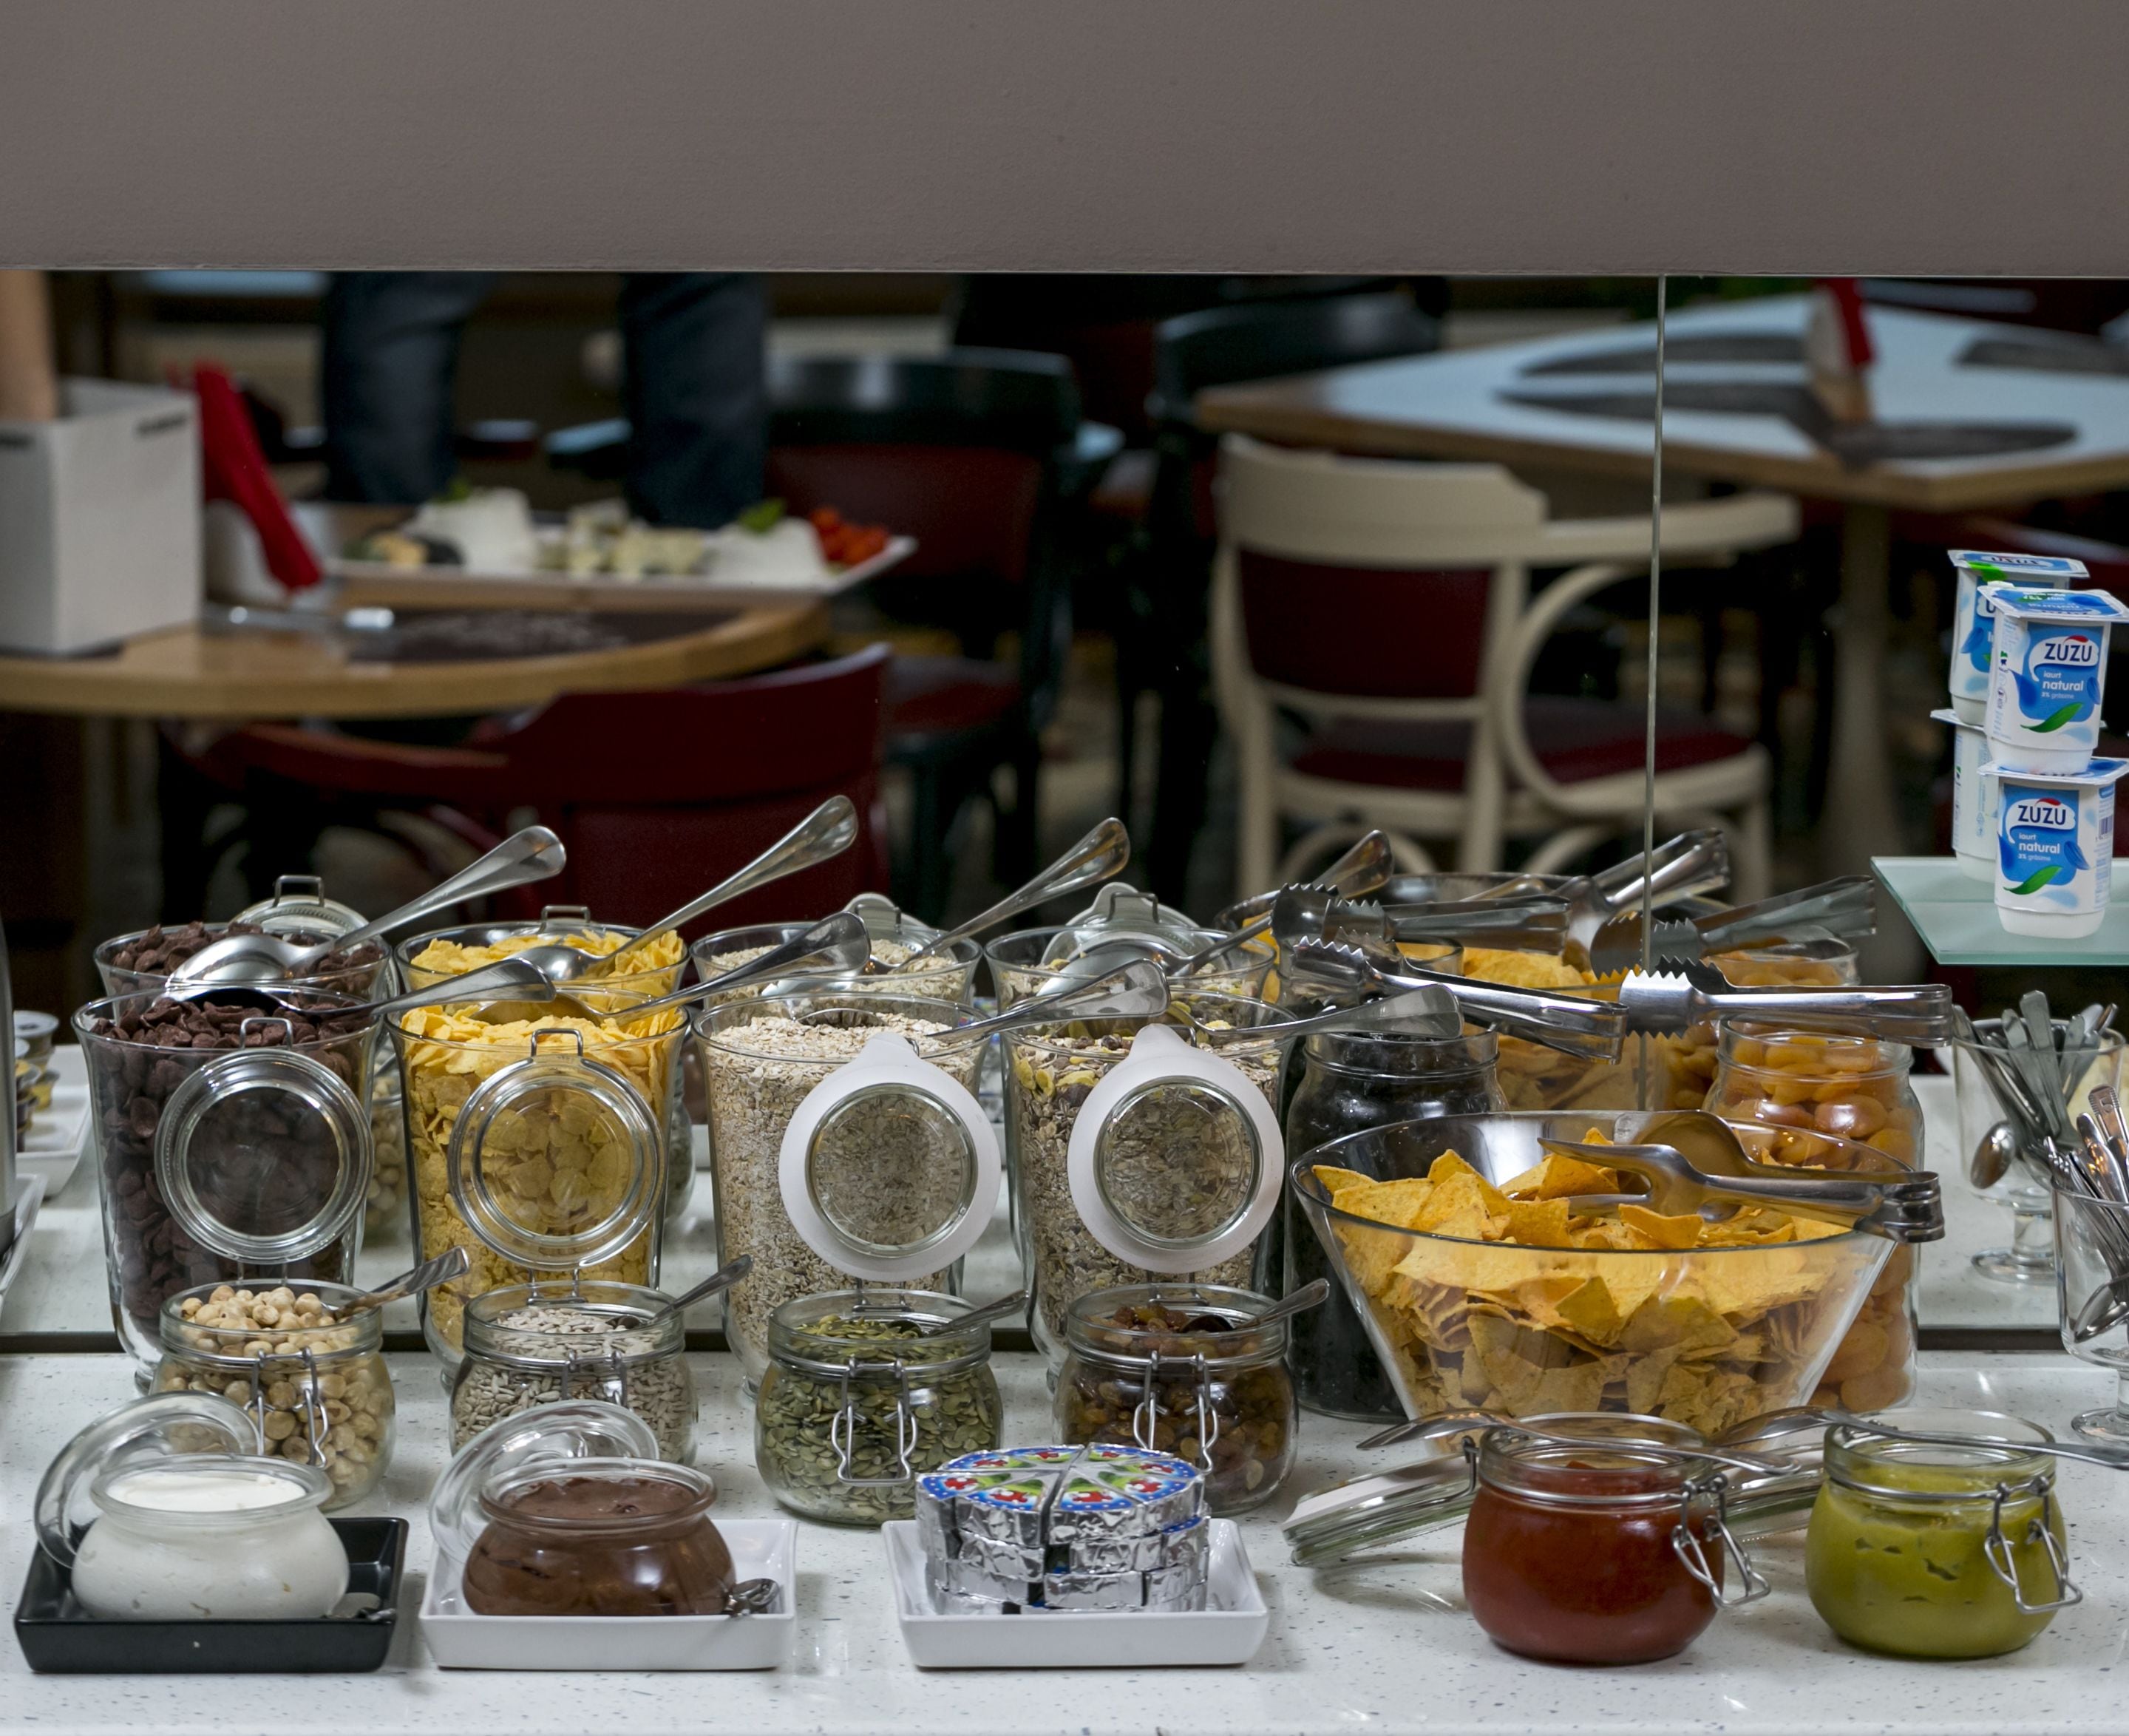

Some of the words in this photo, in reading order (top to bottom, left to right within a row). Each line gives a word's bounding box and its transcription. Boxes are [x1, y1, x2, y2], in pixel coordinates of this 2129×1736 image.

[2044, 642, 2092, 662] ZUZU
[2043, 671, 2062, 679] iaurt
[2043, 680, 2084, 691] natural
[2018, 804, 2066, 825] ZUZU
[2019, 842, 2060, 854] natural
